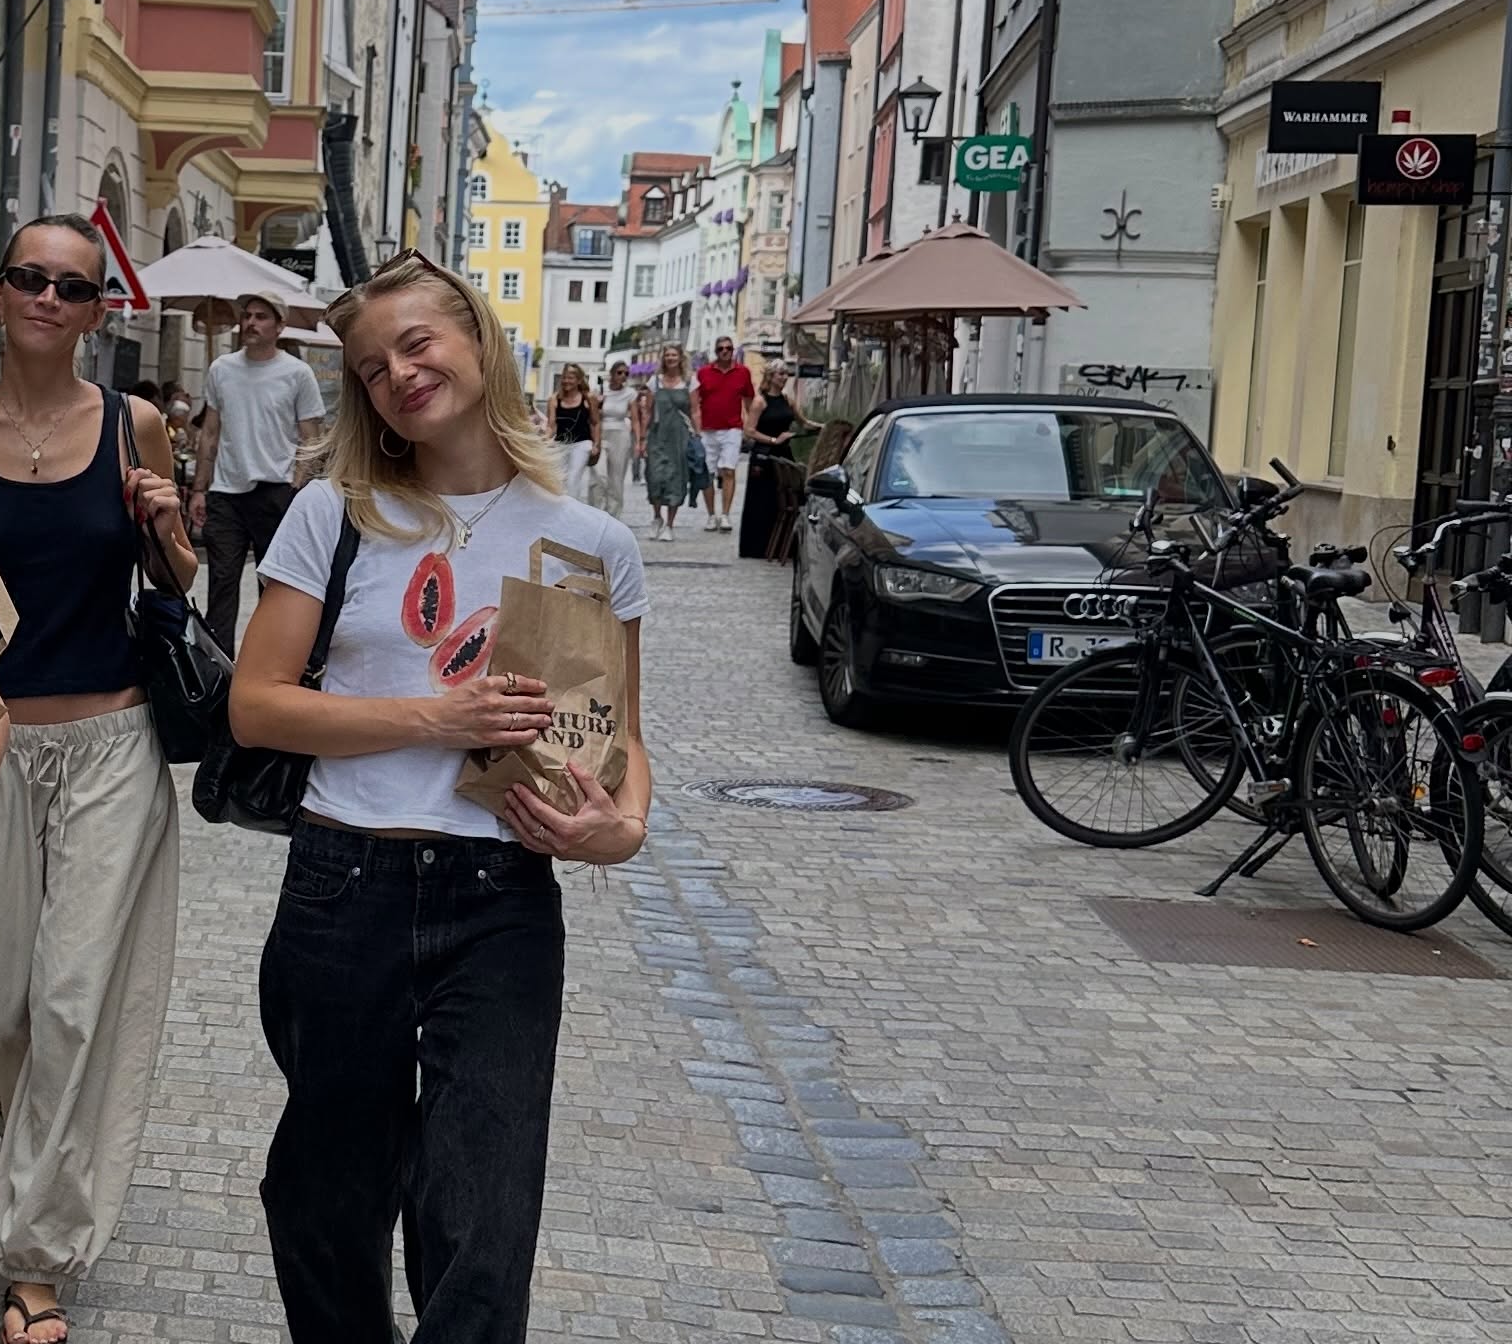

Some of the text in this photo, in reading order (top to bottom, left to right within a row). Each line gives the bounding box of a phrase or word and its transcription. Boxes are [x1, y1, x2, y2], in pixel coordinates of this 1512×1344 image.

[964, 144, 1029, 170] GEA
[551, 711, 617, 736] TURE
[537, 729, 585, 749] AND
